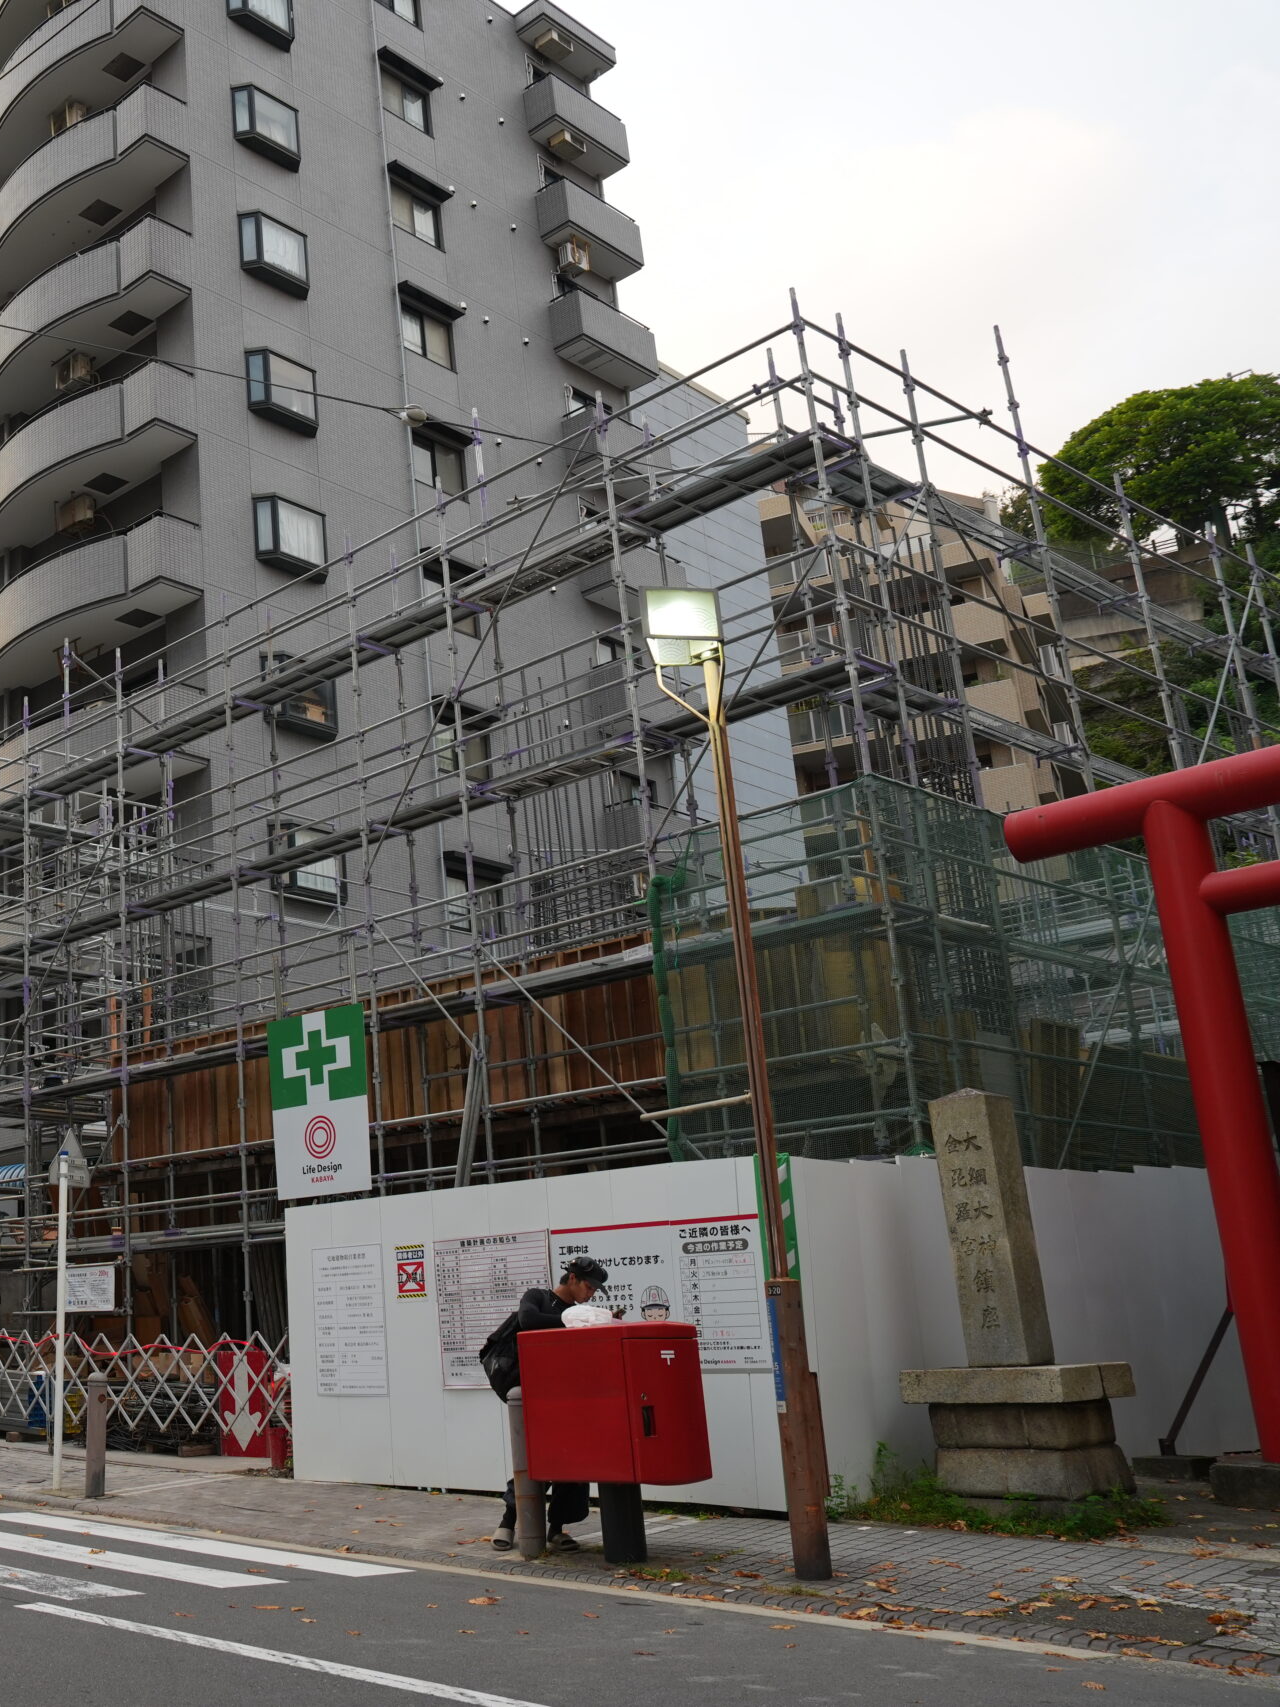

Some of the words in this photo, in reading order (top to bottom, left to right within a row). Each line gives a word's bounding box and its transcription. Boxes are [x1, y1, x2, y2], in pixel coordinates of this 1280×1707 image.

[302, 1164, 316, 1175] Life
[317, 1161, 343, 1174] Design
[311, 1175, 335, 1184] KABAYA
[679, 1224, 751, 1239] ご近隣の皆様へ
[460, 1235, 517, 1247] 建築計画のお知らせ
[687, 1240, 744, 1252] 今週の作業予定
[397, 1251, 424, 1260] 関係者以外
[558, 1245, 589, 1256] 工事中は
[560, 1255, 665, 1270] ごかけしております。
[689, 1258, 696, 1267] 月
[397, 1271, 425, 1283] 立入禁止
[690, 1270, 698, 1278] 火
[691, 1282, 699, 1290] 水
[973, 1269, 1001, 1330] 鎮座
[693, 1305, 700, 1314] 金
[694, 1318, 701, 1326] 土
